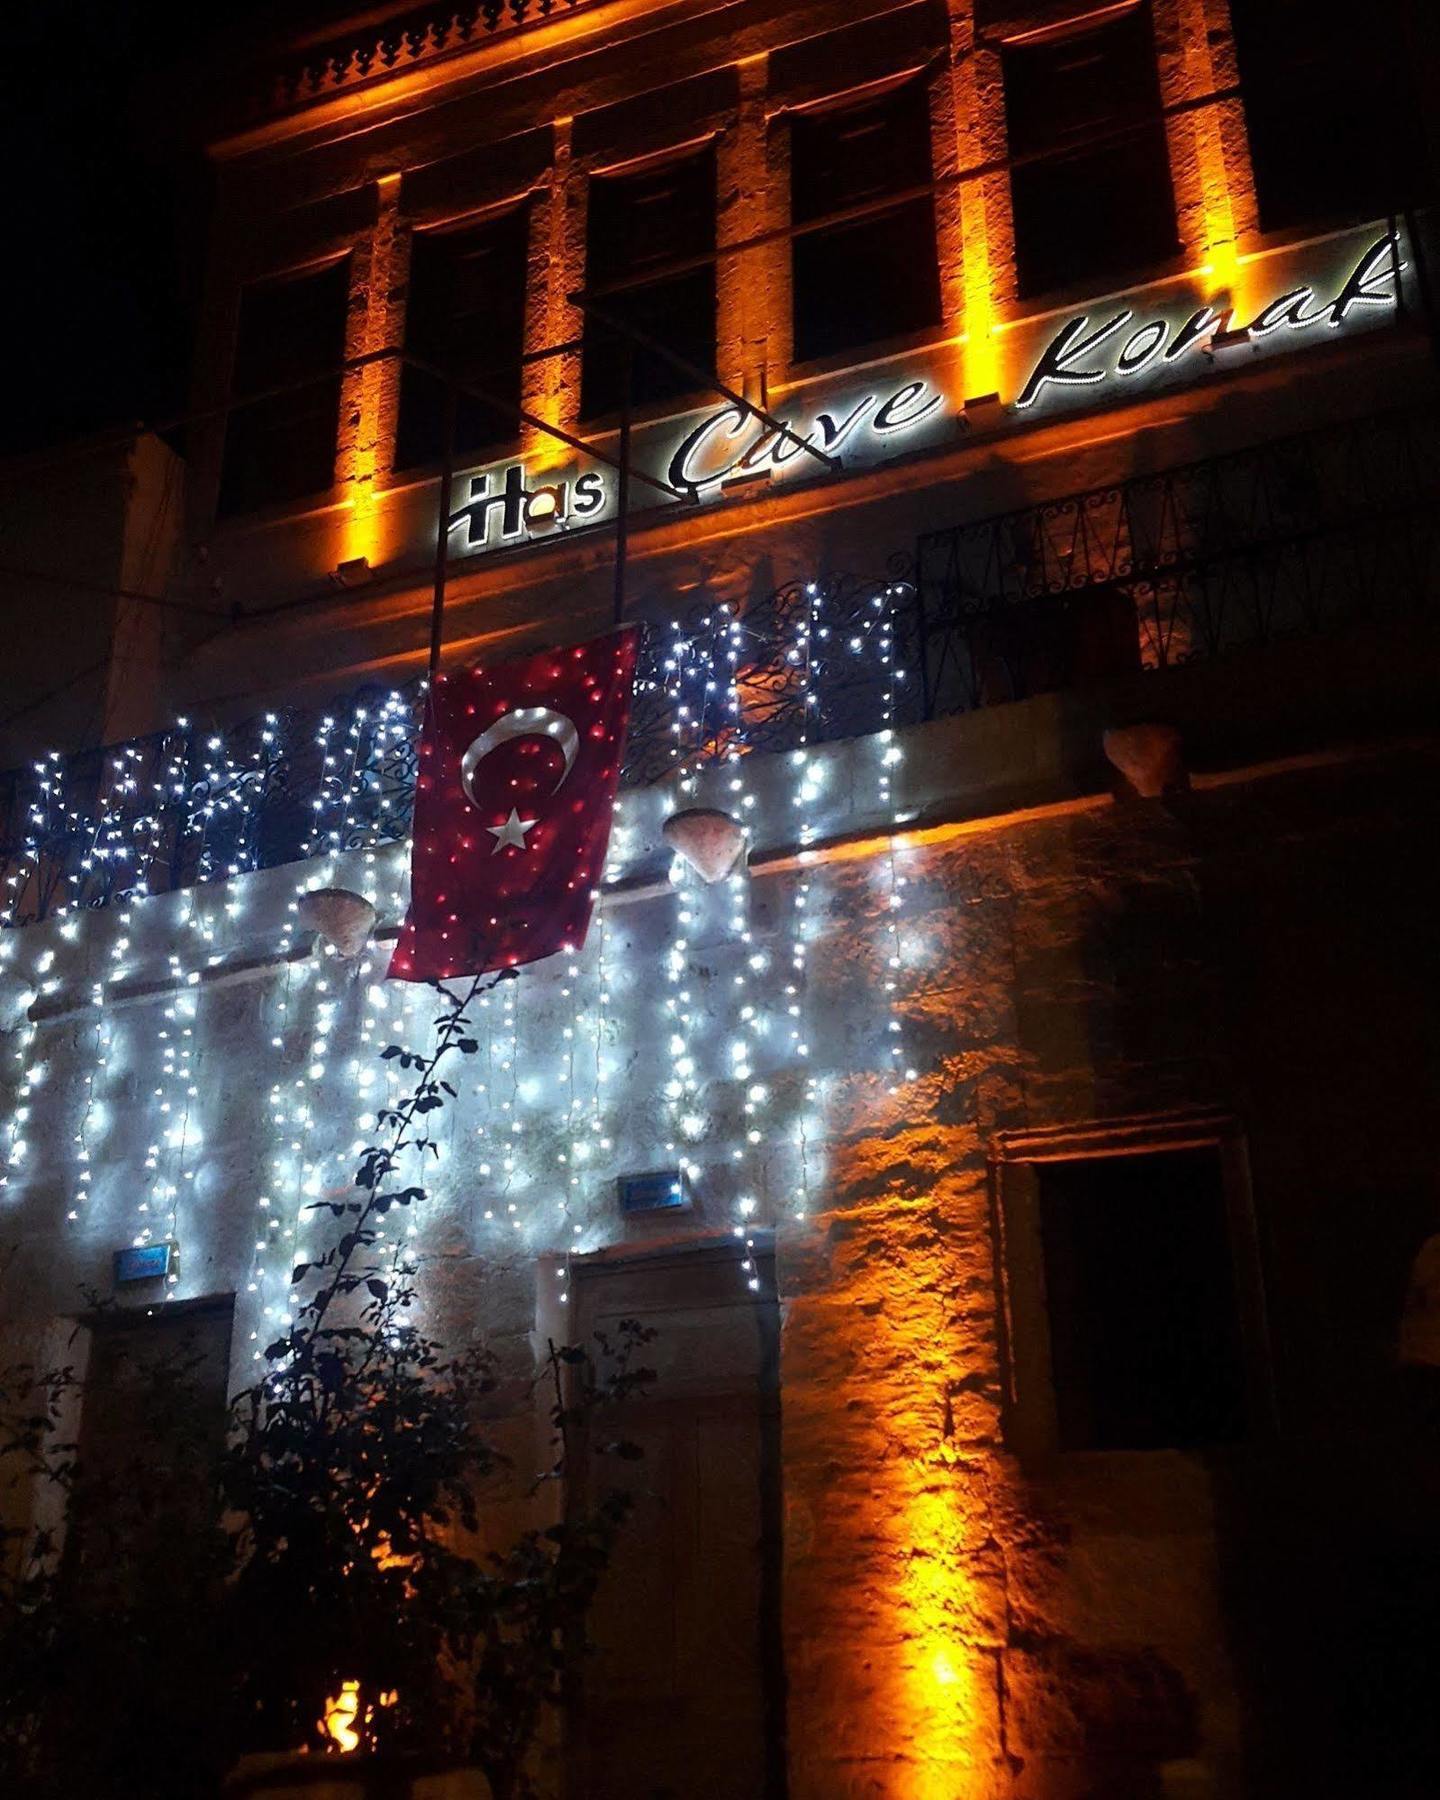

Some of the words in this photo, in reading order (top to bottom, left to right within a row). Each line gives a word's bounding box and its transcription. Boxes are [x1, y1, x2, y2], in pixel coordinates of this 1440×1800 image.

[447, 464, 605, 548] Has
[667, 382, 944, 491] Cave
[1015, 231, 1408, 408] Konak
